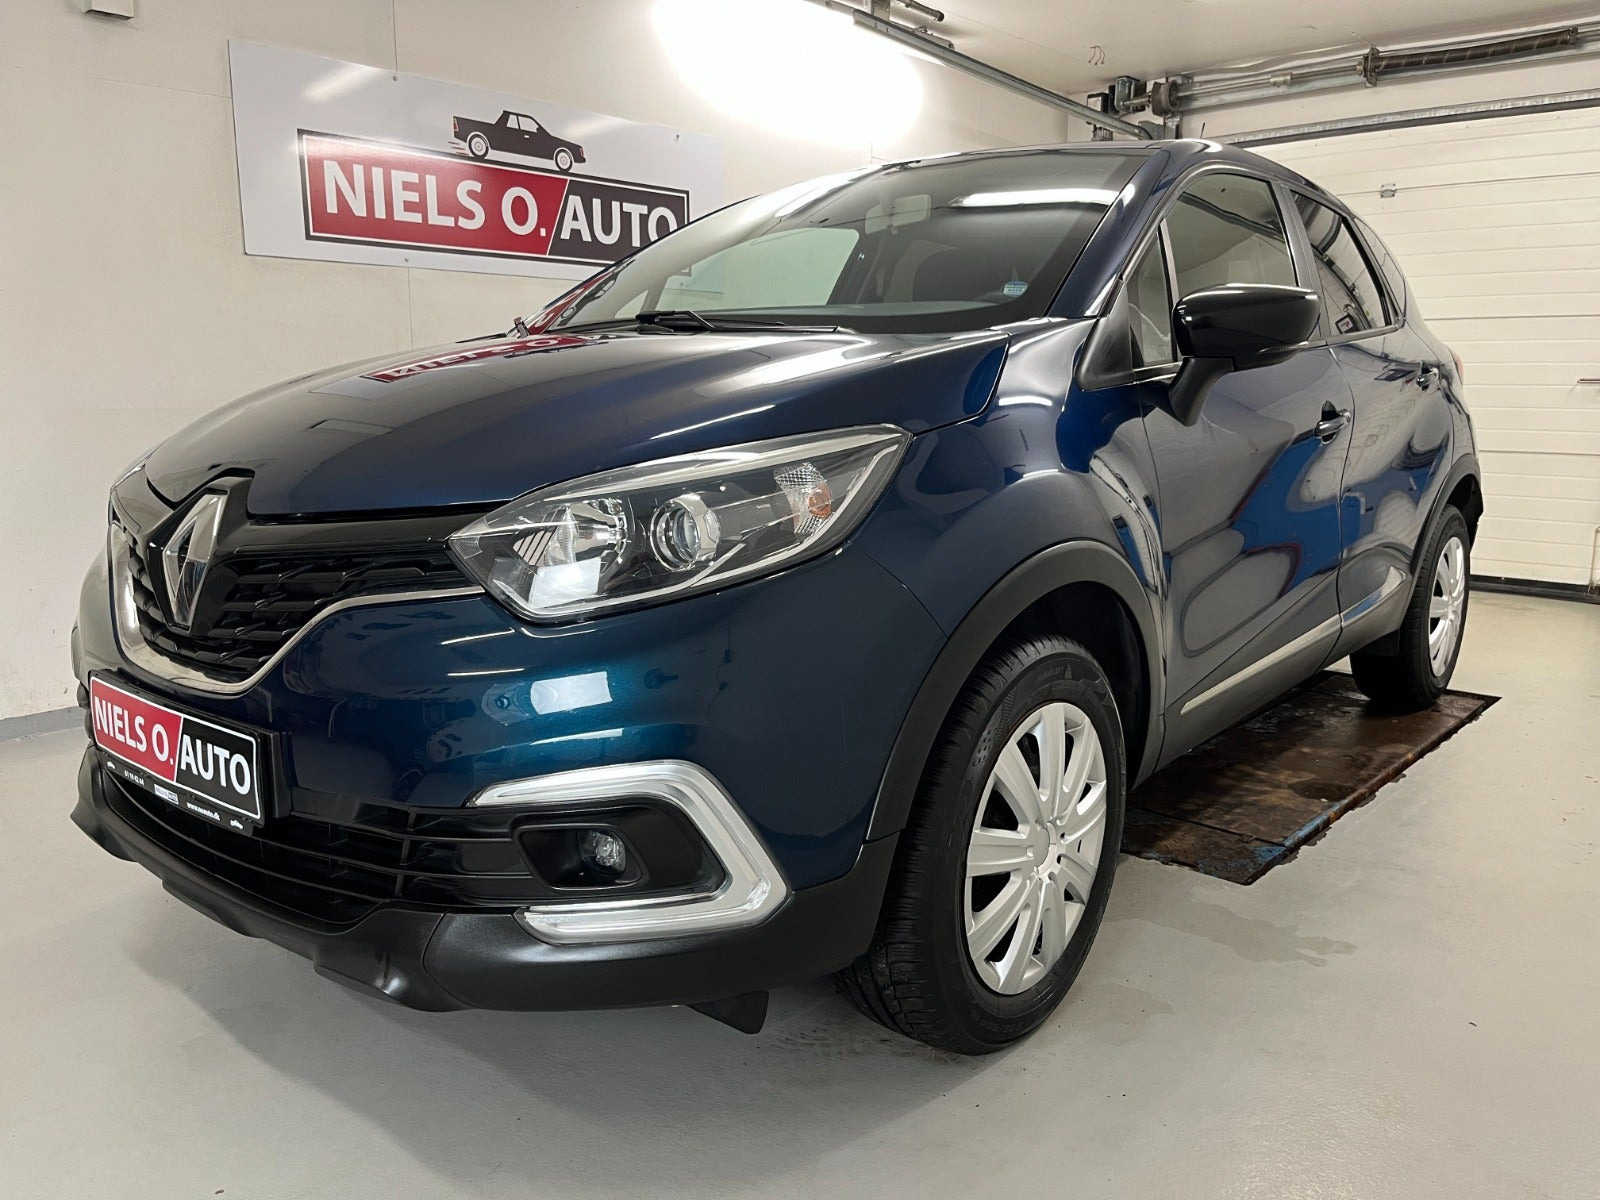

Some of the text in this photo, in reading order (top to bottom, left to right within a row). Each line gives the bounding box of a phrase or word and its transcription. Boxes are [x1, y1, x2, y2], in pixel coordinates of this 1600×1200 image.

[322, 160, 678, 248] NIELS O. AUTO
[94, 696, 252, 796] NIELS O. AUTO
